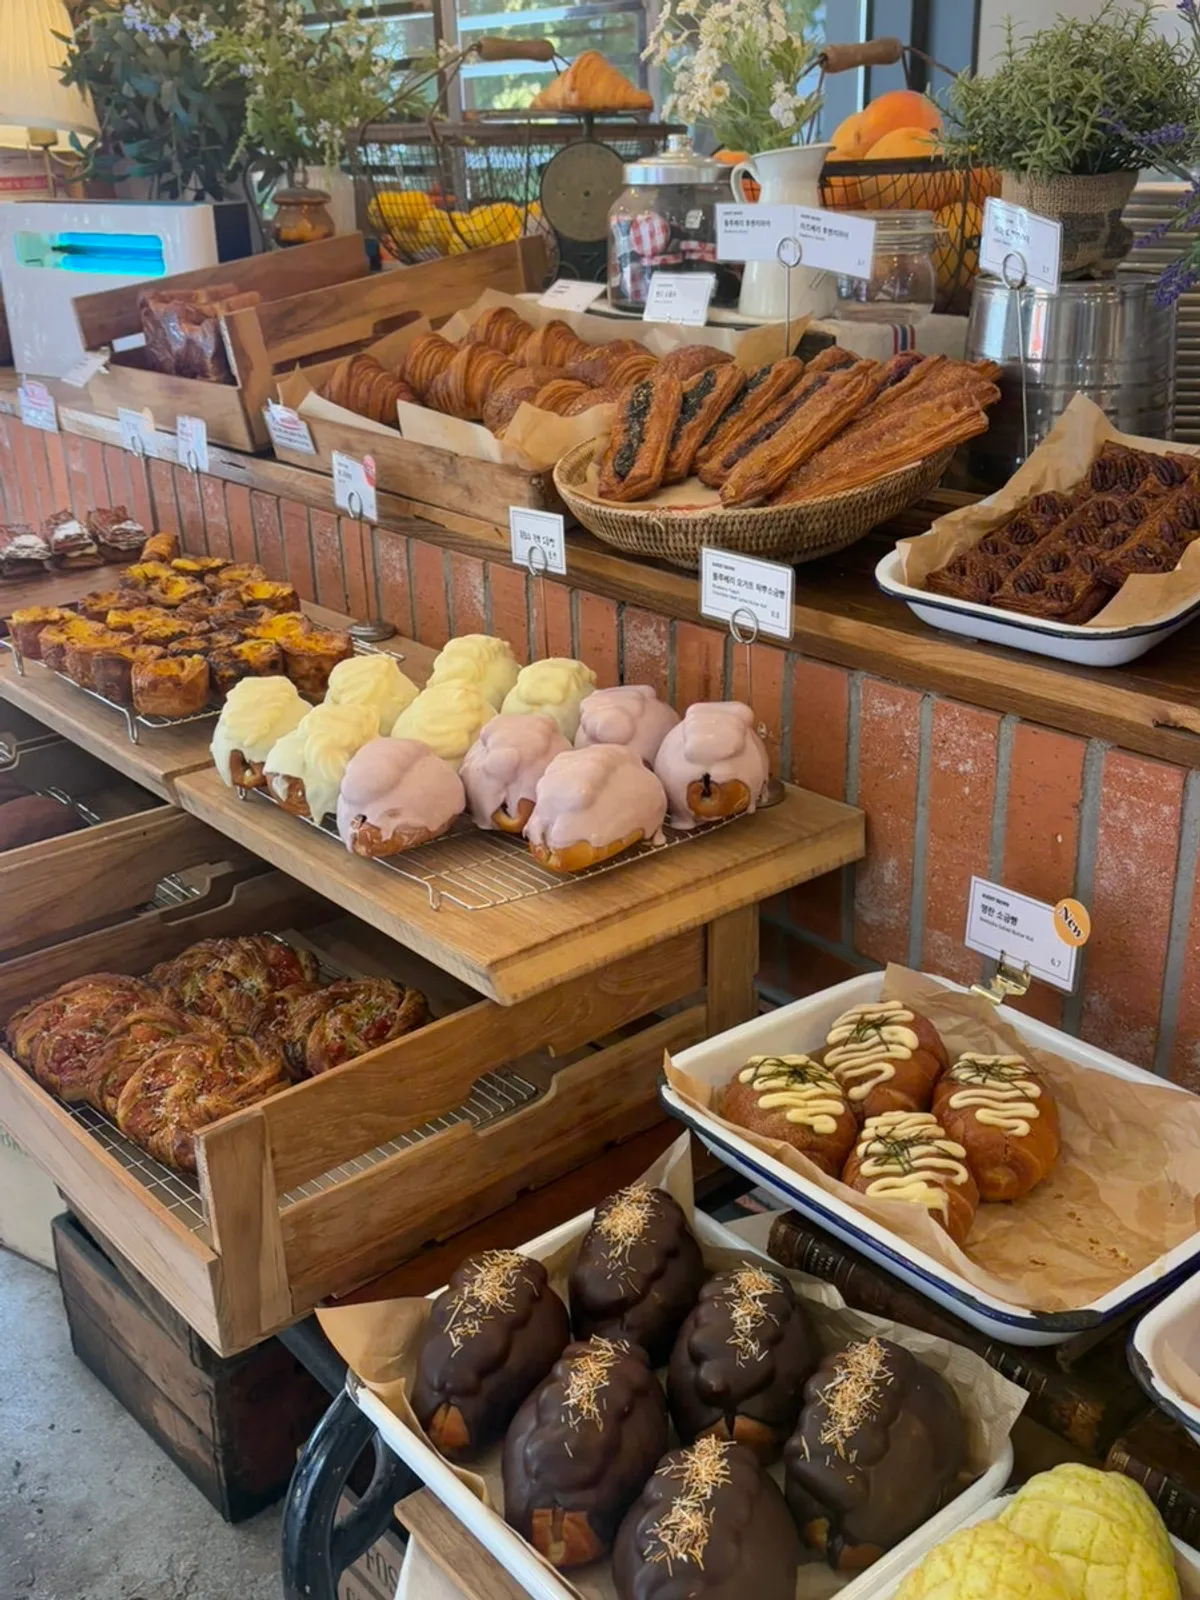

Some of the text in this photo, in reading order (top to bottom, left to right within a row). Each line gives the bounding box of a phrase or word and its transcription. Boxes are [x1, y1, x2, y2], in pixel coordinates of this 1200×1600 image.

[712, 572, 735, 586] 블루베리
[736, 579, 753, 591] 요거트
[980, 903, 1018, 926] 명란 소금빵
[1050, 957, 1062, 968] 6.7
